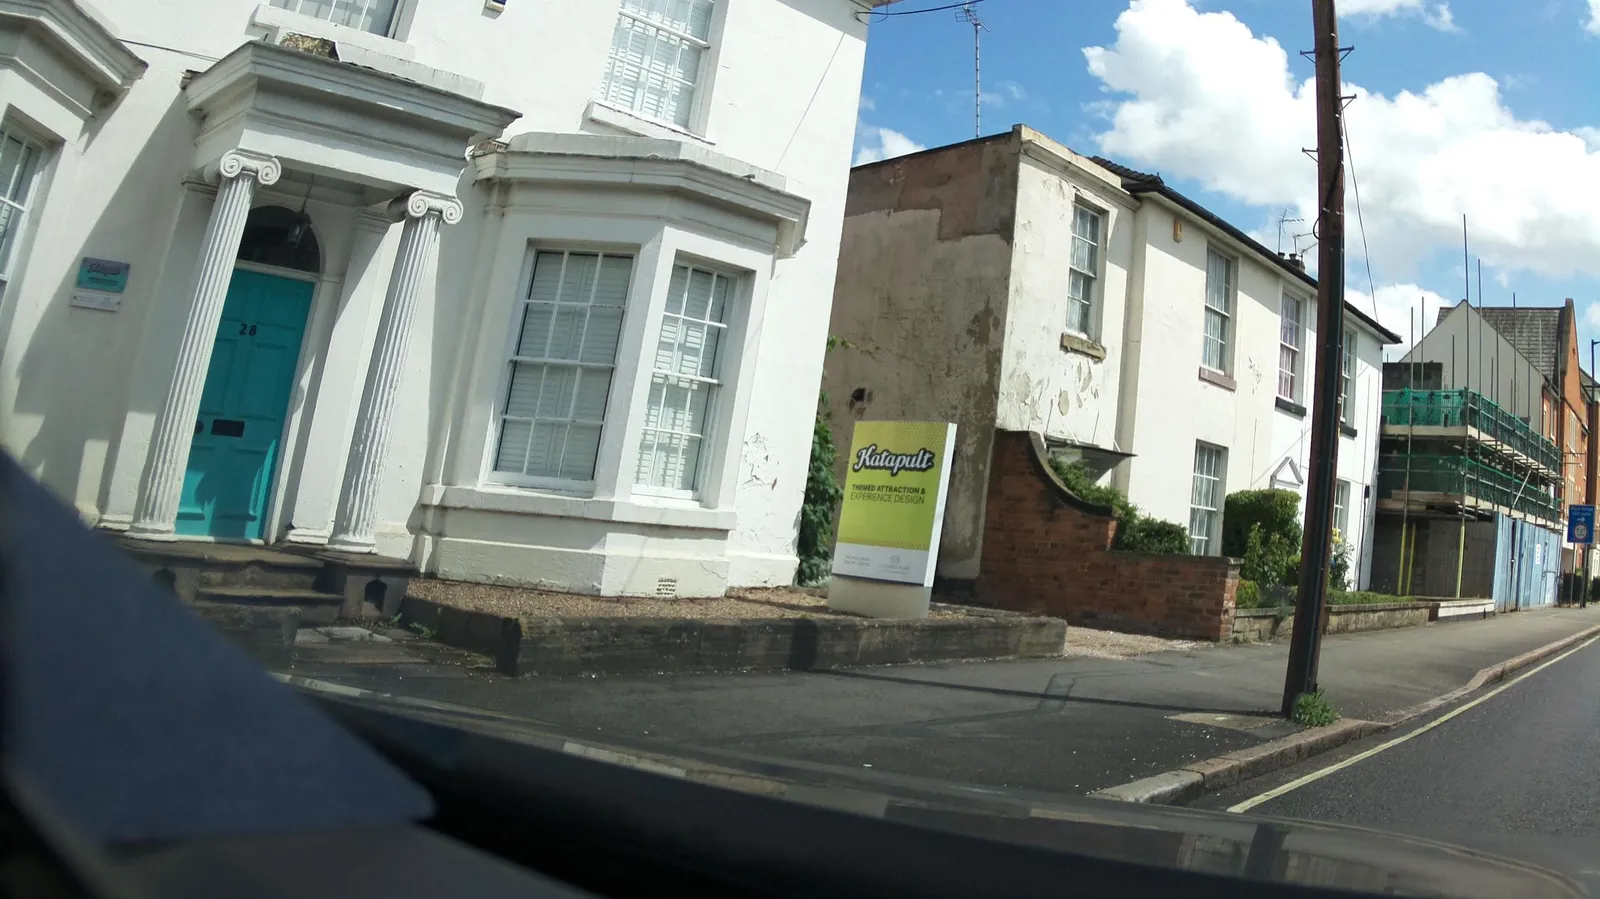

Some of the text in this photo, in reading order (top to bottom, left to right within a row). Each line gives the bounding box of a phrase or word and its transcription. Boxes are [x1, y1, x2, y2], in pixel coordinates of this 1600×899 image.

[239, 323, 257, 336] 28
[853, 443, 935, 477] Katapult
[852, 484, 926, 495] THEMED ATTRACTION &
[850, 491, 925, 504] EXPERIENCE DESIGN
